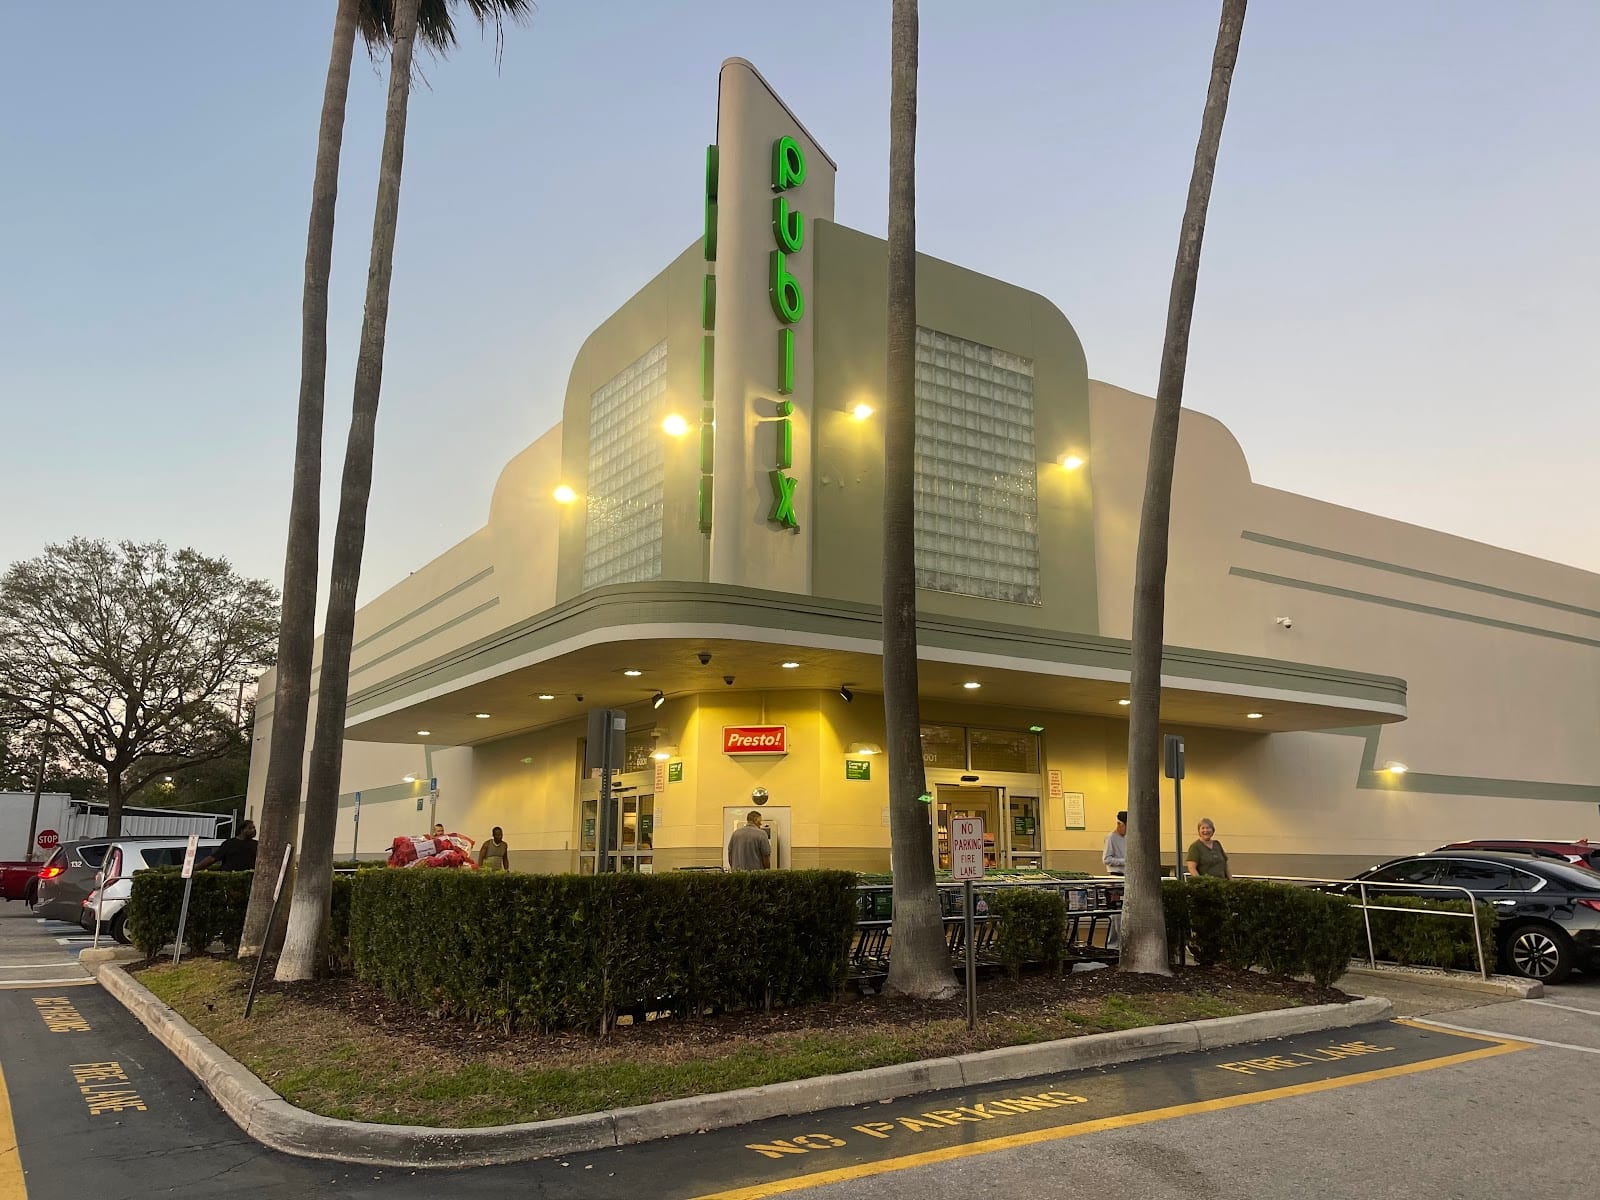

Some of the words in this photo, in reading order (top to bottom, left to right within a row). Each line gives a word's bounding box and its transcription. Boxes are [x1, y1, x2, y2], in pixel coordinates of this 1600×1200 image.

[768, 135, 807, 528] publix
[728, 733, 782, 746] Presto!
[961, 823, 974, 834] NO
[38, 835, 58, 844] STOP
[954, 839, 982, 851] PARKING
[961, 854, 976, 864] FIRE
[960, 867, 977, 877] LANE
[1215, 1055, 1313, 1075] FIRE
[1290, 1041, 1396, 1062] LANE
[69, 1061, 129, 1083] FIRE
[79, 1082, 148, 1116] LANE
[744, 1133, 847, 1159] NO
[851, 1091, 1089, 1139] PARKING
